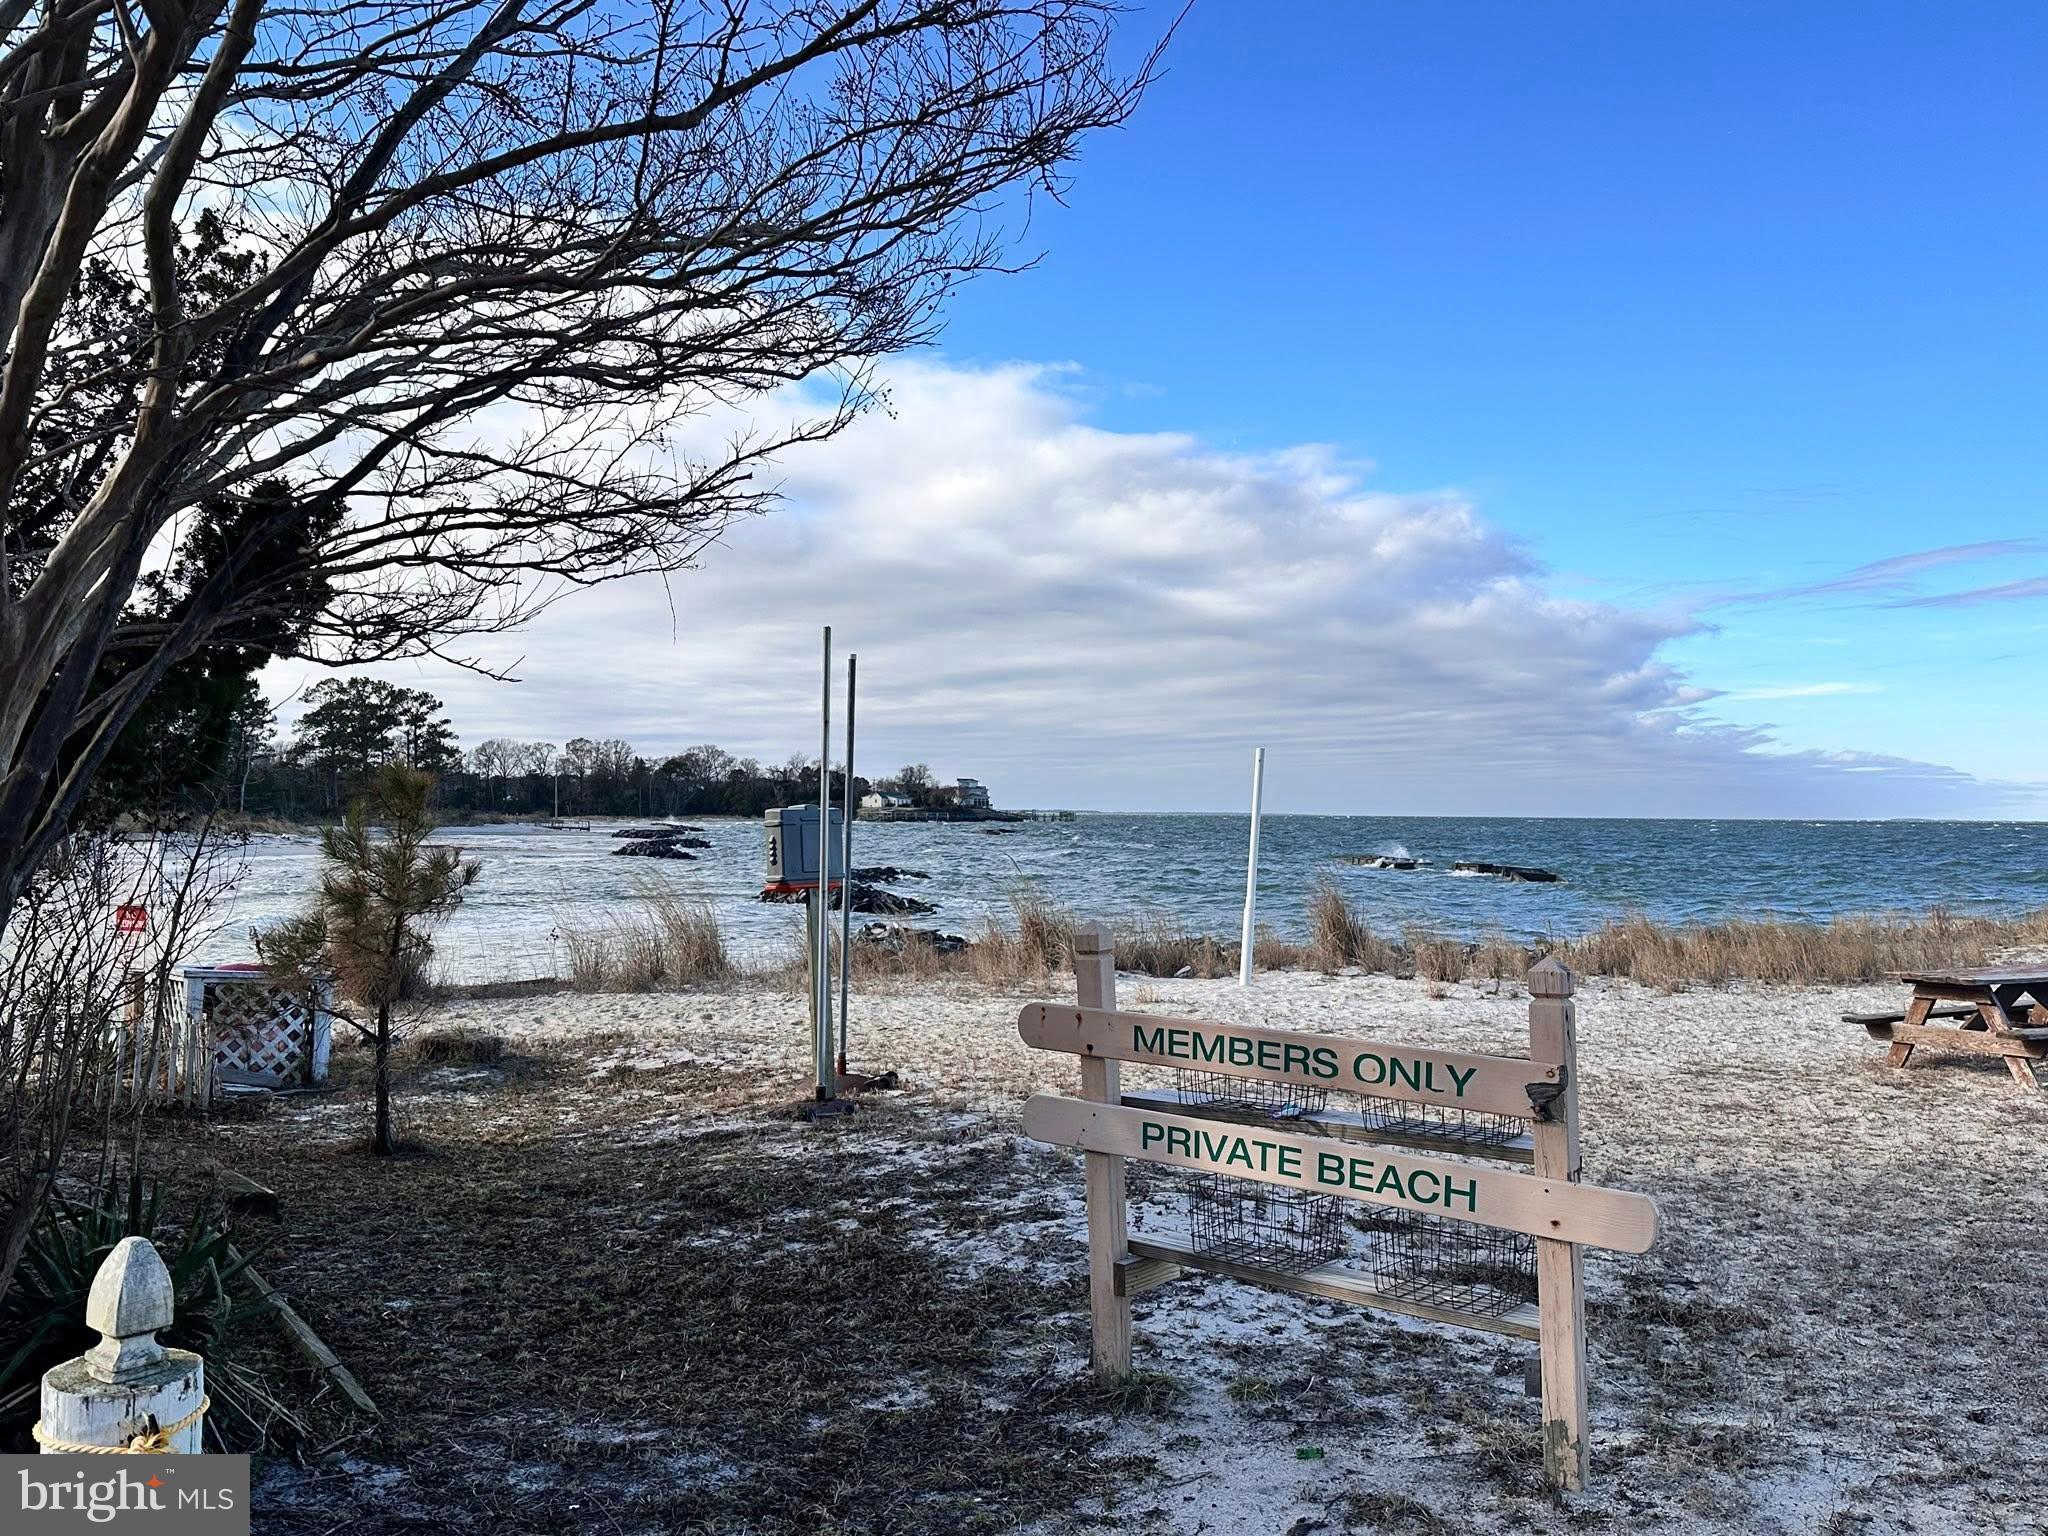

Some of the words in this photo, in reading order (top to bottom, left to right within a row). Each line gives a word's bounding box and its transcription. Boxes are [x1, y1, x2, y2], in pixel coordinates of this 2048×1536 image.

[1133, 1025, 1339, 1079] MEMBERS
[1353, 1053, 1477, 1097] ONLY
[1142, 1121, 1302, 1179] PRIVATE
[1317, 1152, 1477, 1213] BEACH
